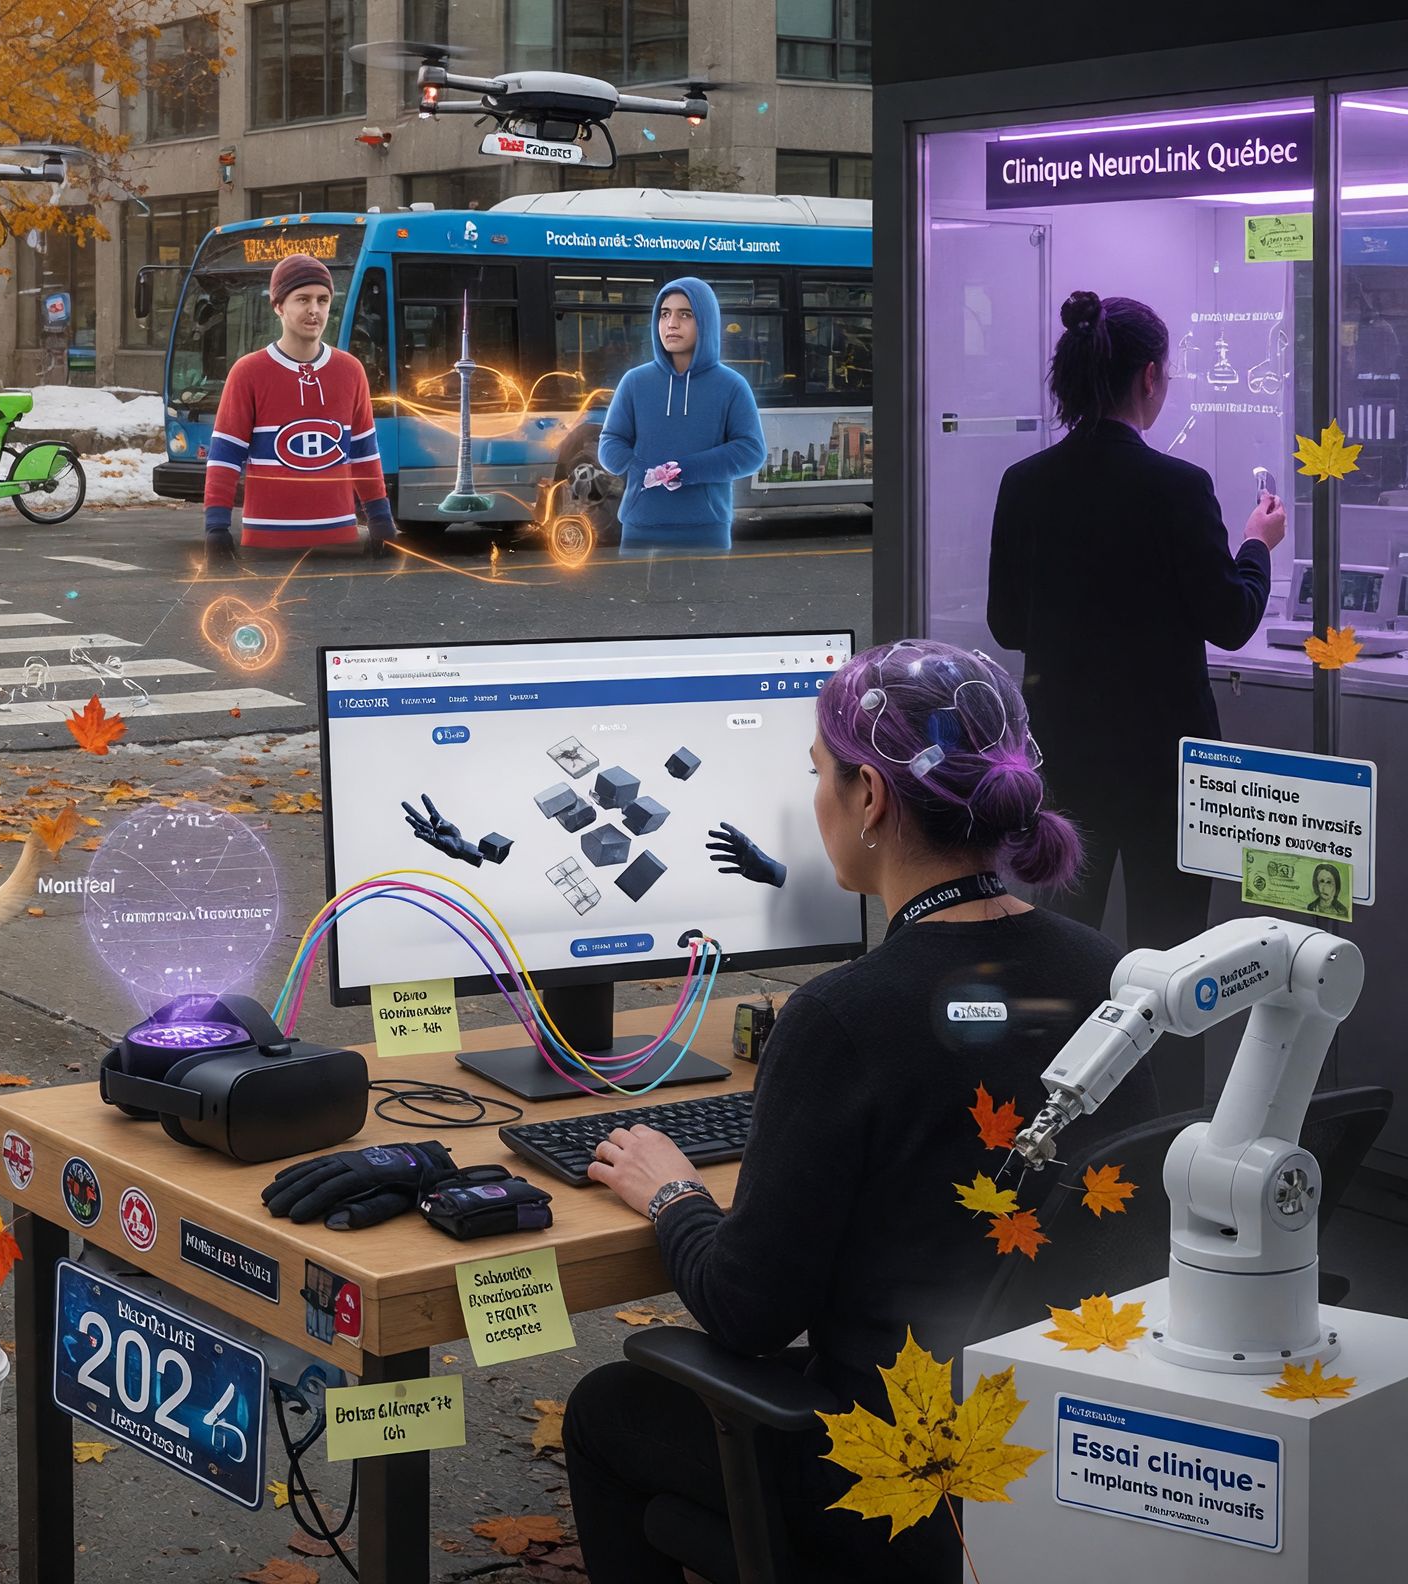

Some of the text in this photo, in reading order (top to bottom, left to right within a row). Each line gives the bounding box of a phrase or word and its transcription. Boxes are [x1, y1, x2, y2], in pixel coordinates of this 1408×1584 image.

[1002, 137, 1298, 187] Clinique NeuroLink Québec
[1241, 782, 1300, 804] clinique
[1072, 1431, 1140, 1468] Essai
[1147, 1450, 1253, 1491] clinique
[1083, 1467, 1159, 1498] Implants
[1162, 1487, 1194, 1506] non
[1198, 1492, 1265, 1521] invasifs
